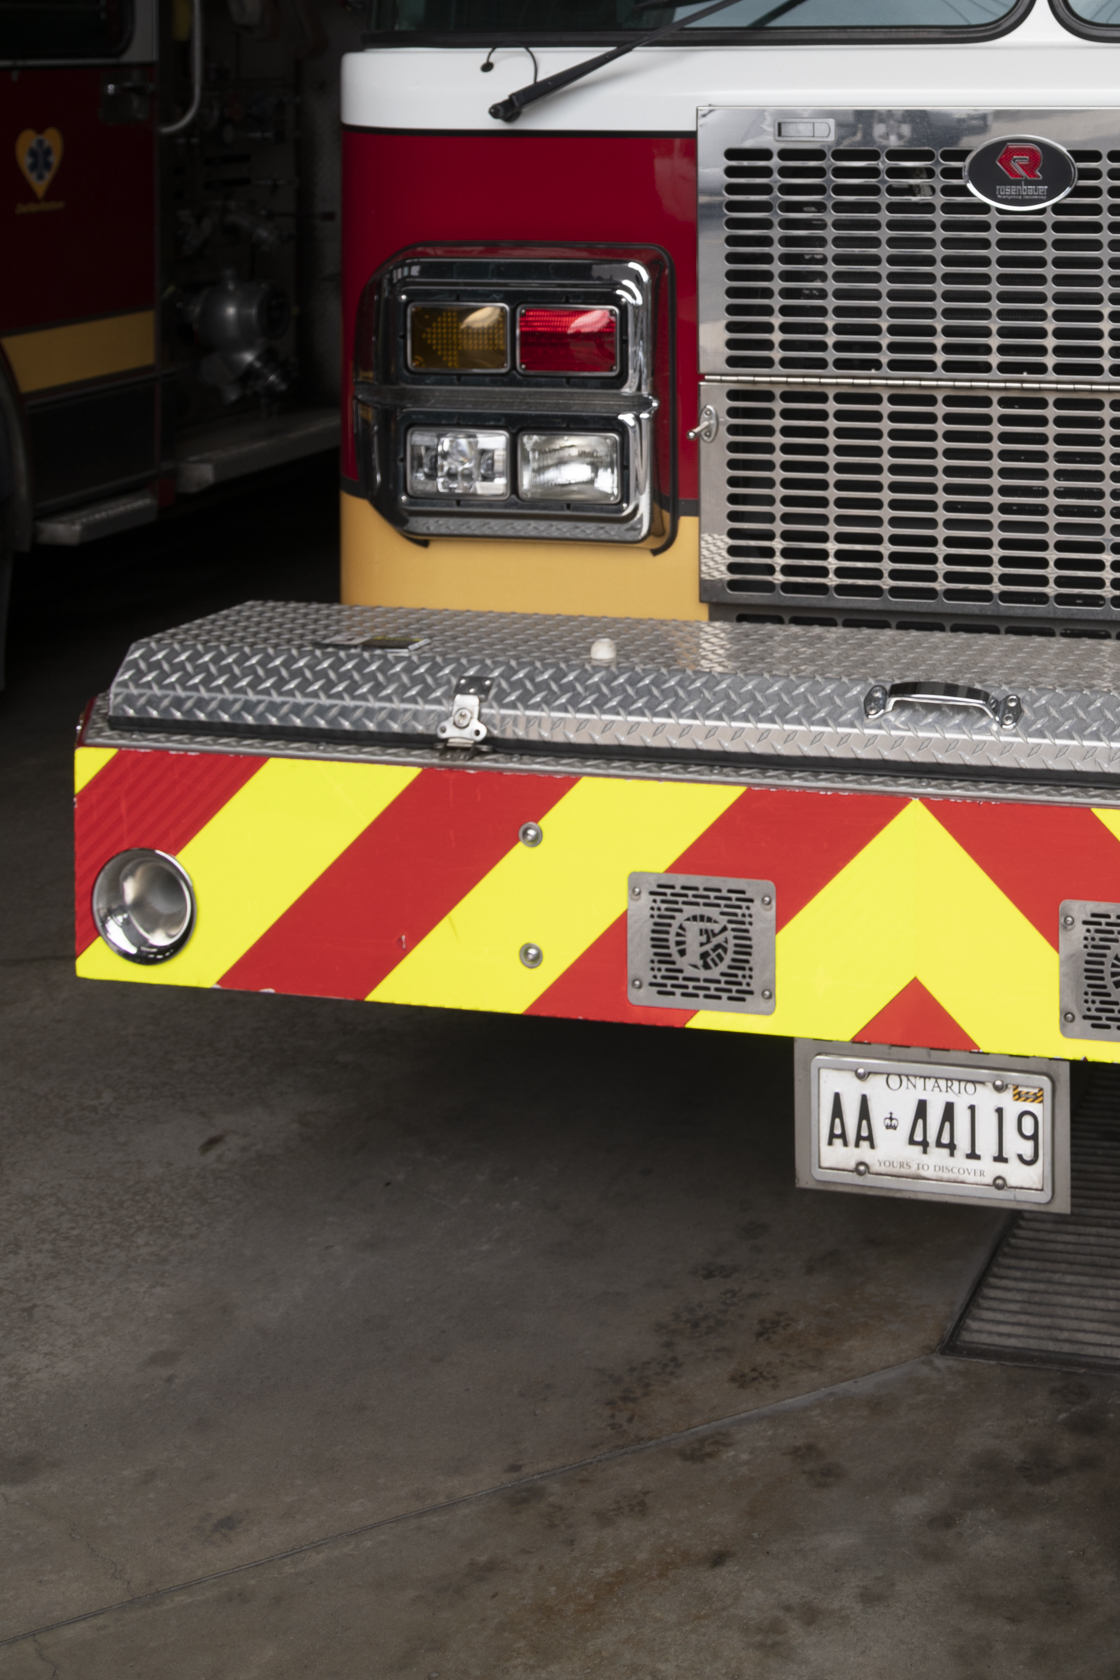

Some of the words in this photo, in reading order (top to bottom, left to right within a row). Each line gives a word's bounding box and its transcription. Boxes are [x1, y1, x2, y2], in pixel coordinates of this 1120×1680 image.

[996, 181, 1048, 195] rosenbauer
[885, 1073, 977, 1097] ONTARIO
[827, 1091, 876, 1150] AA
[907, 1098, 1040, 1167] 44119
[877, 1159, 912, 1170] YOURS
[915, 1163, 930, 1172] TO
[933, 1164, 986, 1178] DISCOVER
